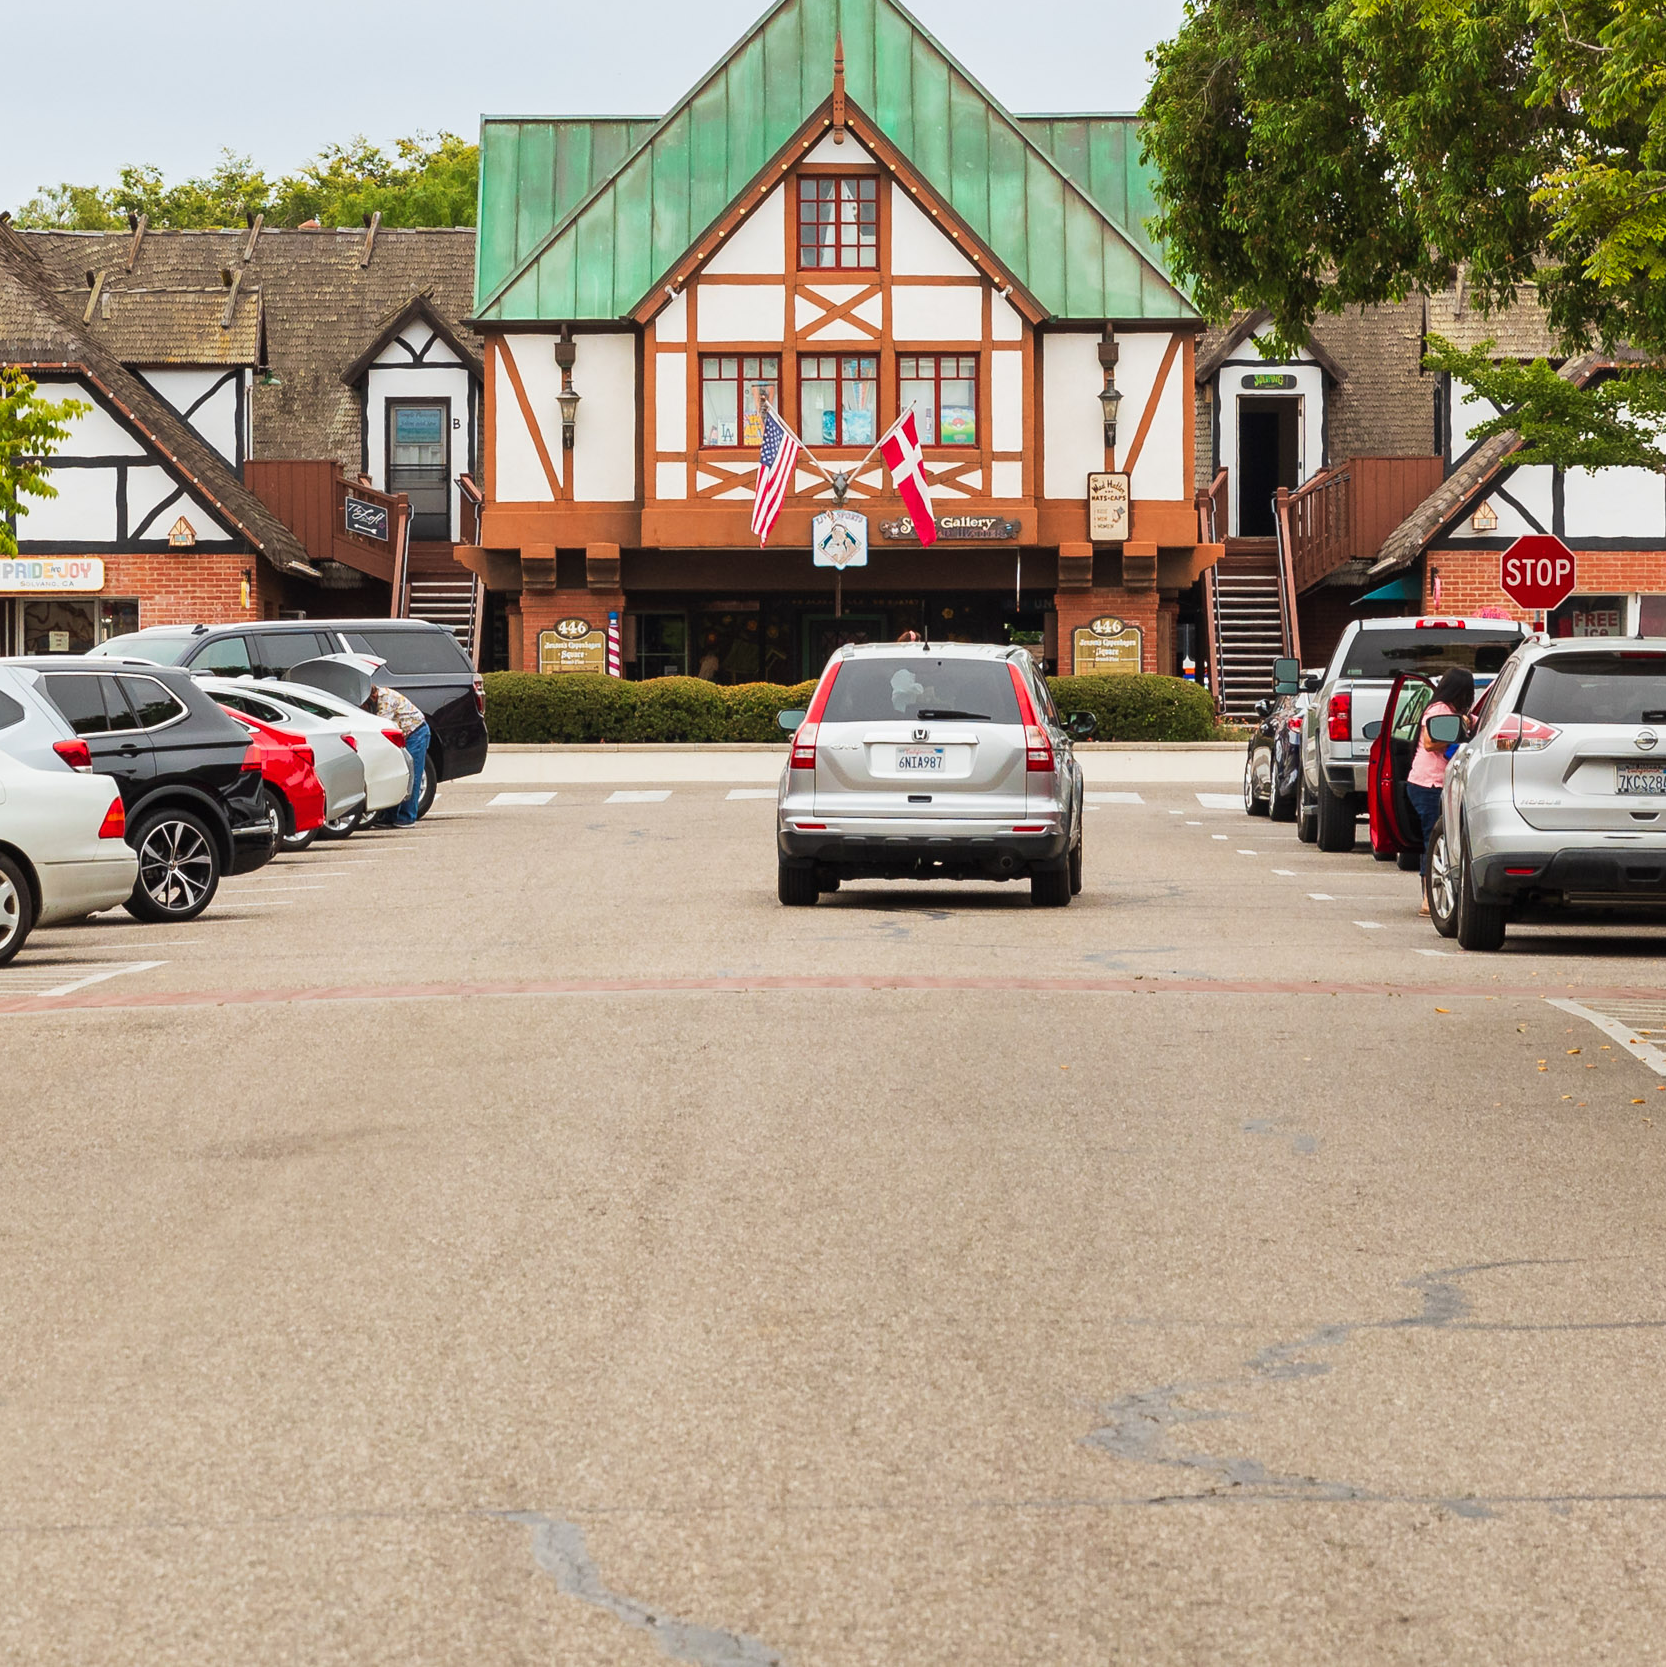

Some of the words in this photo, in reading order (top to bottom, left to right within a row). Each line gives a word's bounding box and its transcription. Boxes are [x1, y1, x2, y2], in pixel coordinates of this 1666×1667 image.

[453, 418, 461, 430] B
[940, 516, 996, 531] Gallery
[2, 562, 54, 579] PRIDE
[58, 562, 92, 579] JOY
[1505, 558, 1571, 587] STOP
[1093, 619, 1121, 633] 446
[1574, 612, 1619, 628] FREE
[558, 621, 587, 635] 446
[898, 756, 943, 770] 6NIA987
